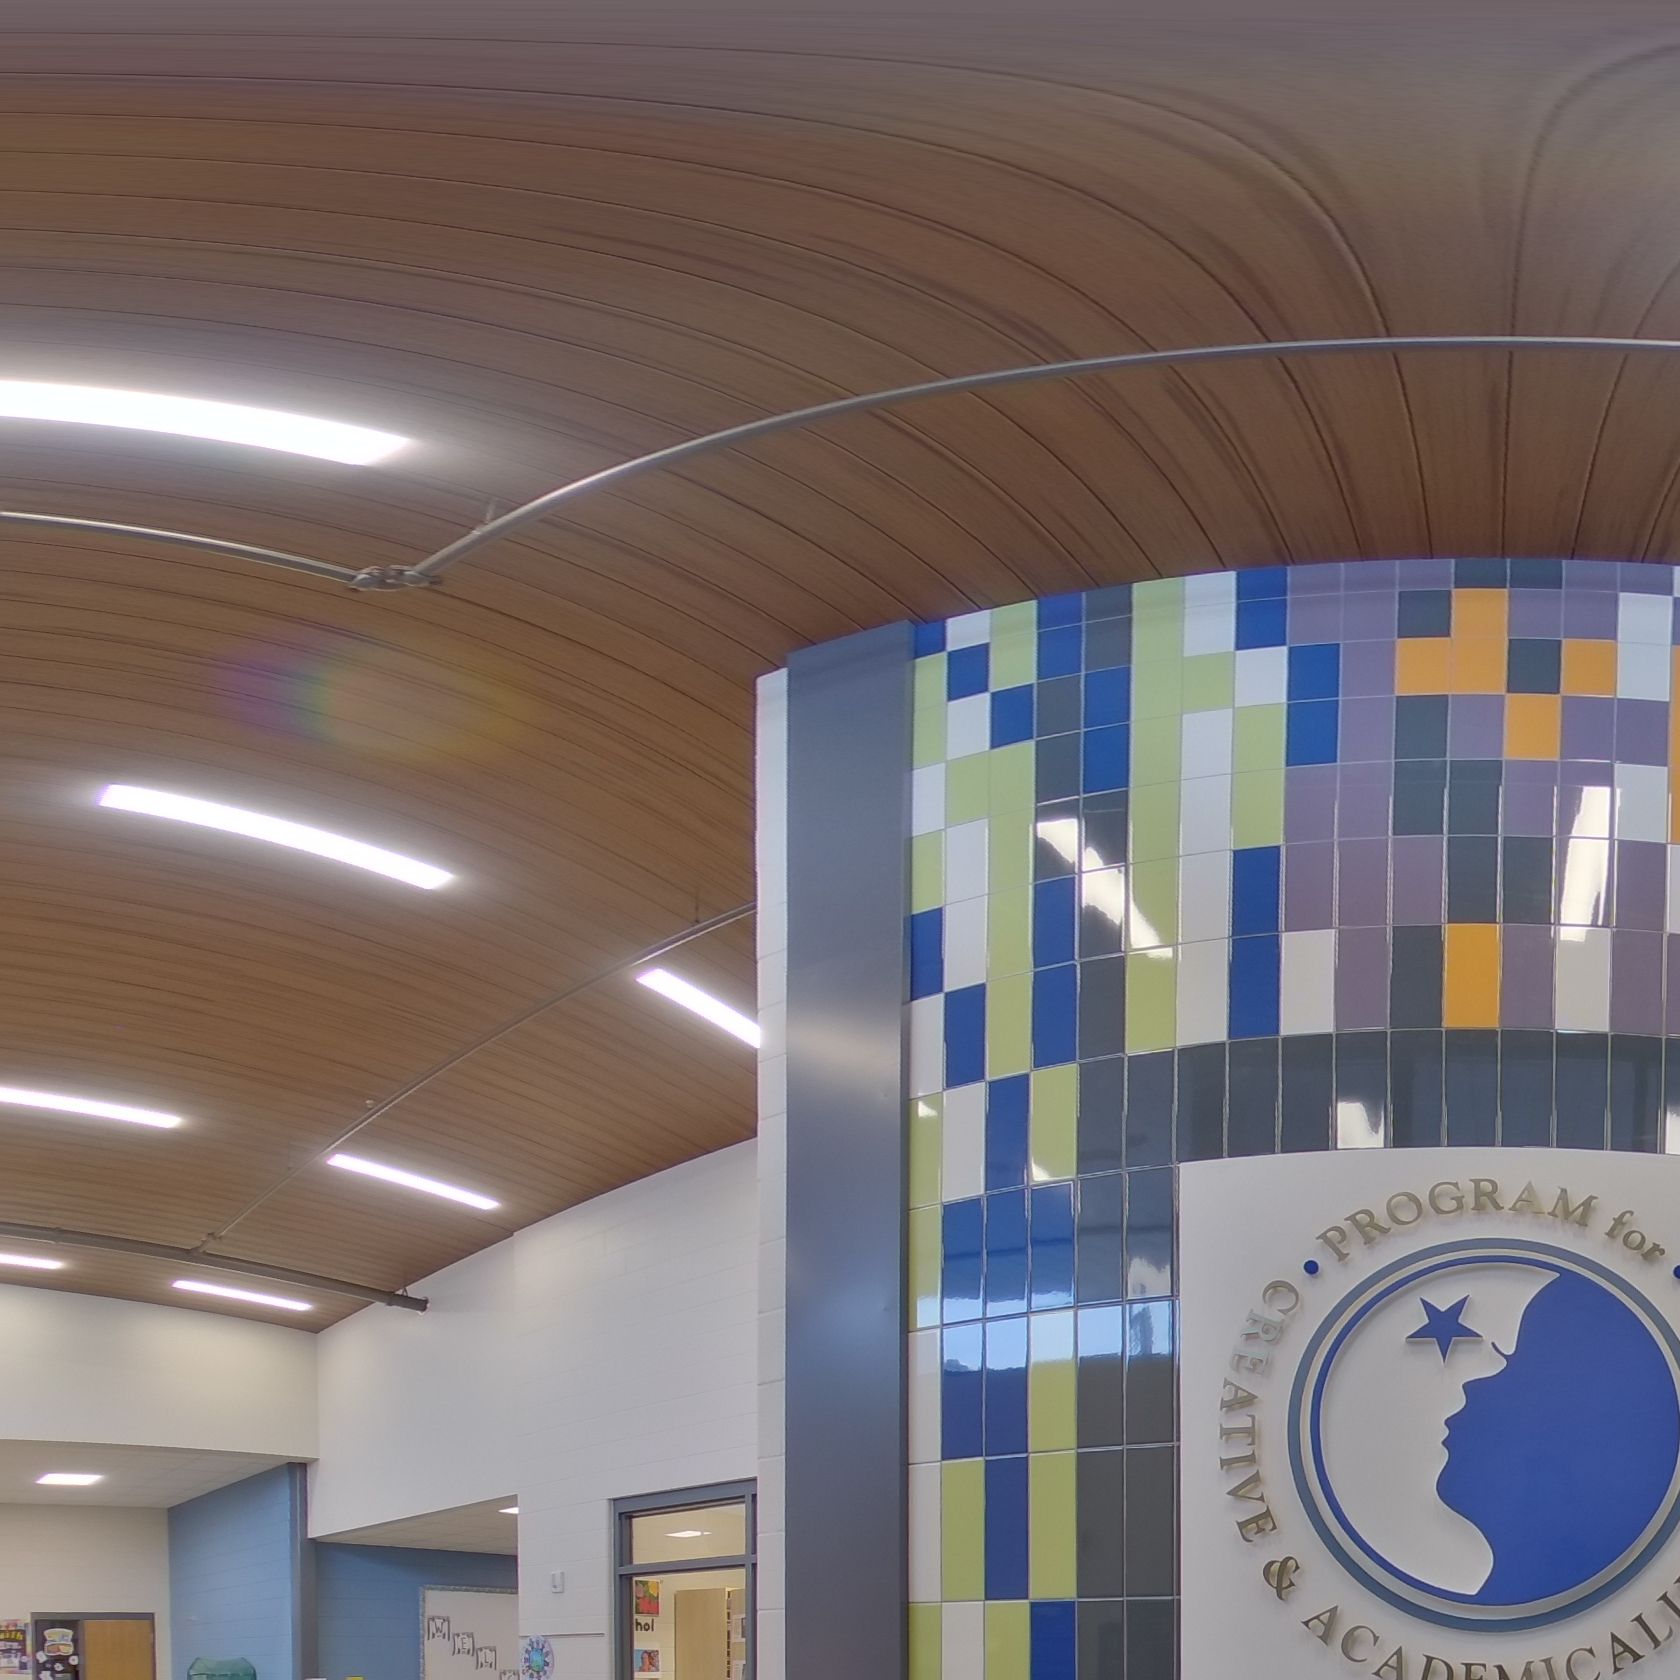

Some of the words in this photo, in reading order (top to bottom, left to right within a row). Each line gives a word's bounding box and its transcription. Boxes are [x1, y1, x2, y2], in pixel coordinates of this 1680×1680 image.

[1315, 1177, 1599, 1262] PROGRAM
[1604, 1209, 1666, 1263] for
[1219, 1279, 1301, 1544] CREATIVE
[1262, 1556, 1302, 1600] &
[635, 1618, 655, 1631] hol
